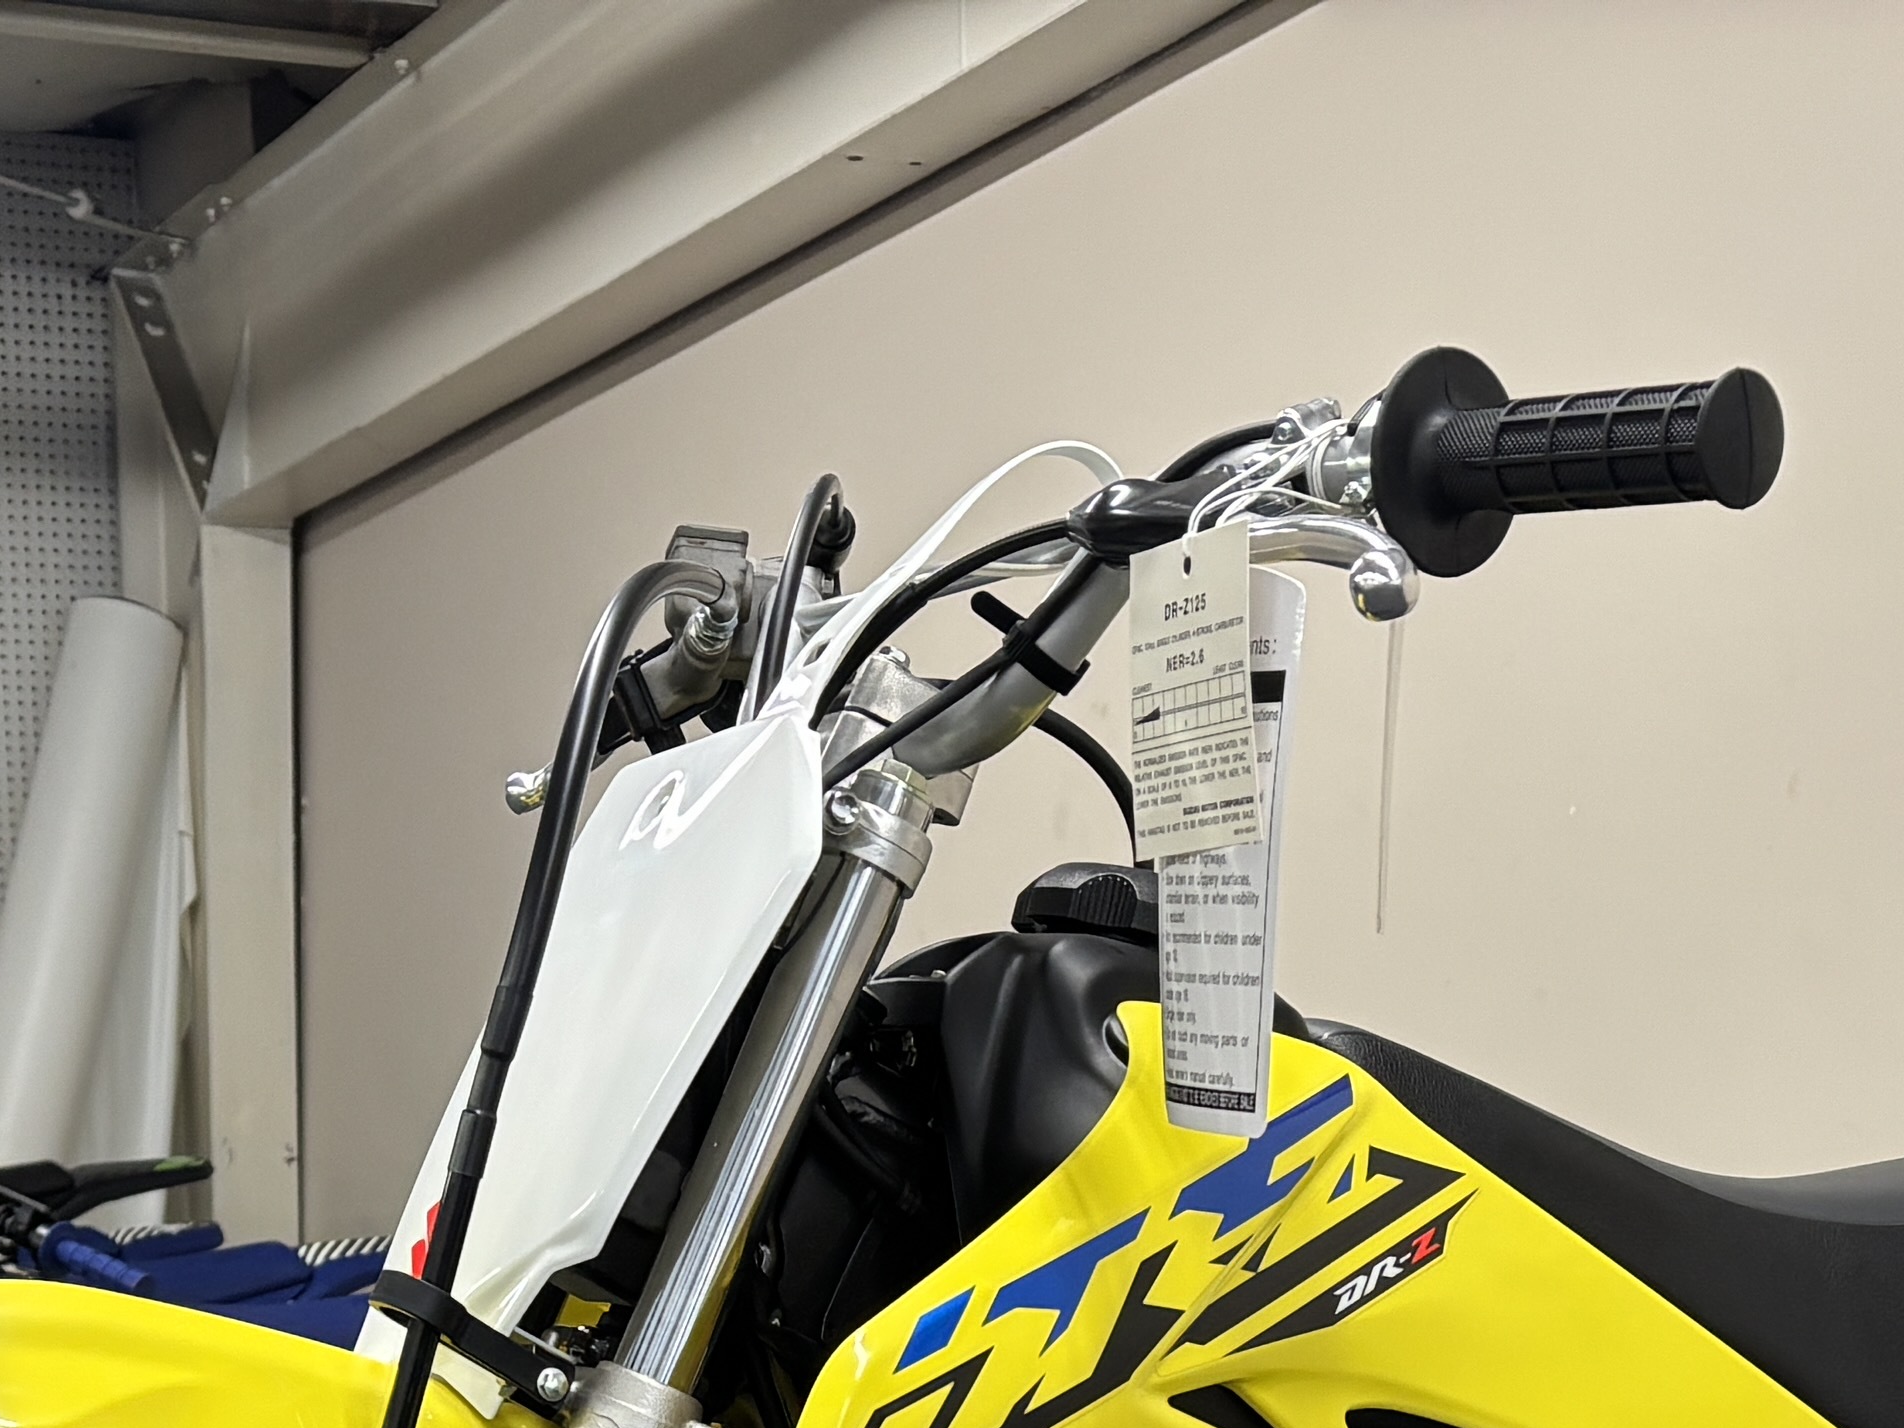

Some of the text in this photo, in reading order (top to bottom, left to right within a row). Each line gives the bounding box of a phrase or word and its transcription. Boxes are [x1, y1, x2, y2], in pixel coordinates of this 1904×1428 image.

[1164, 593, 1206, 622] DR-Z125
[1165, 649, 1205, 673] NER=2.6
[1213, 931, 1239, 946] children
[1241, 932, 1263, 946] under
[1232, 971, 1261, 987] children
[1220, 1034, 1238, 1049] parts
[1332, 1226, 1442, 1315] DR-Z
